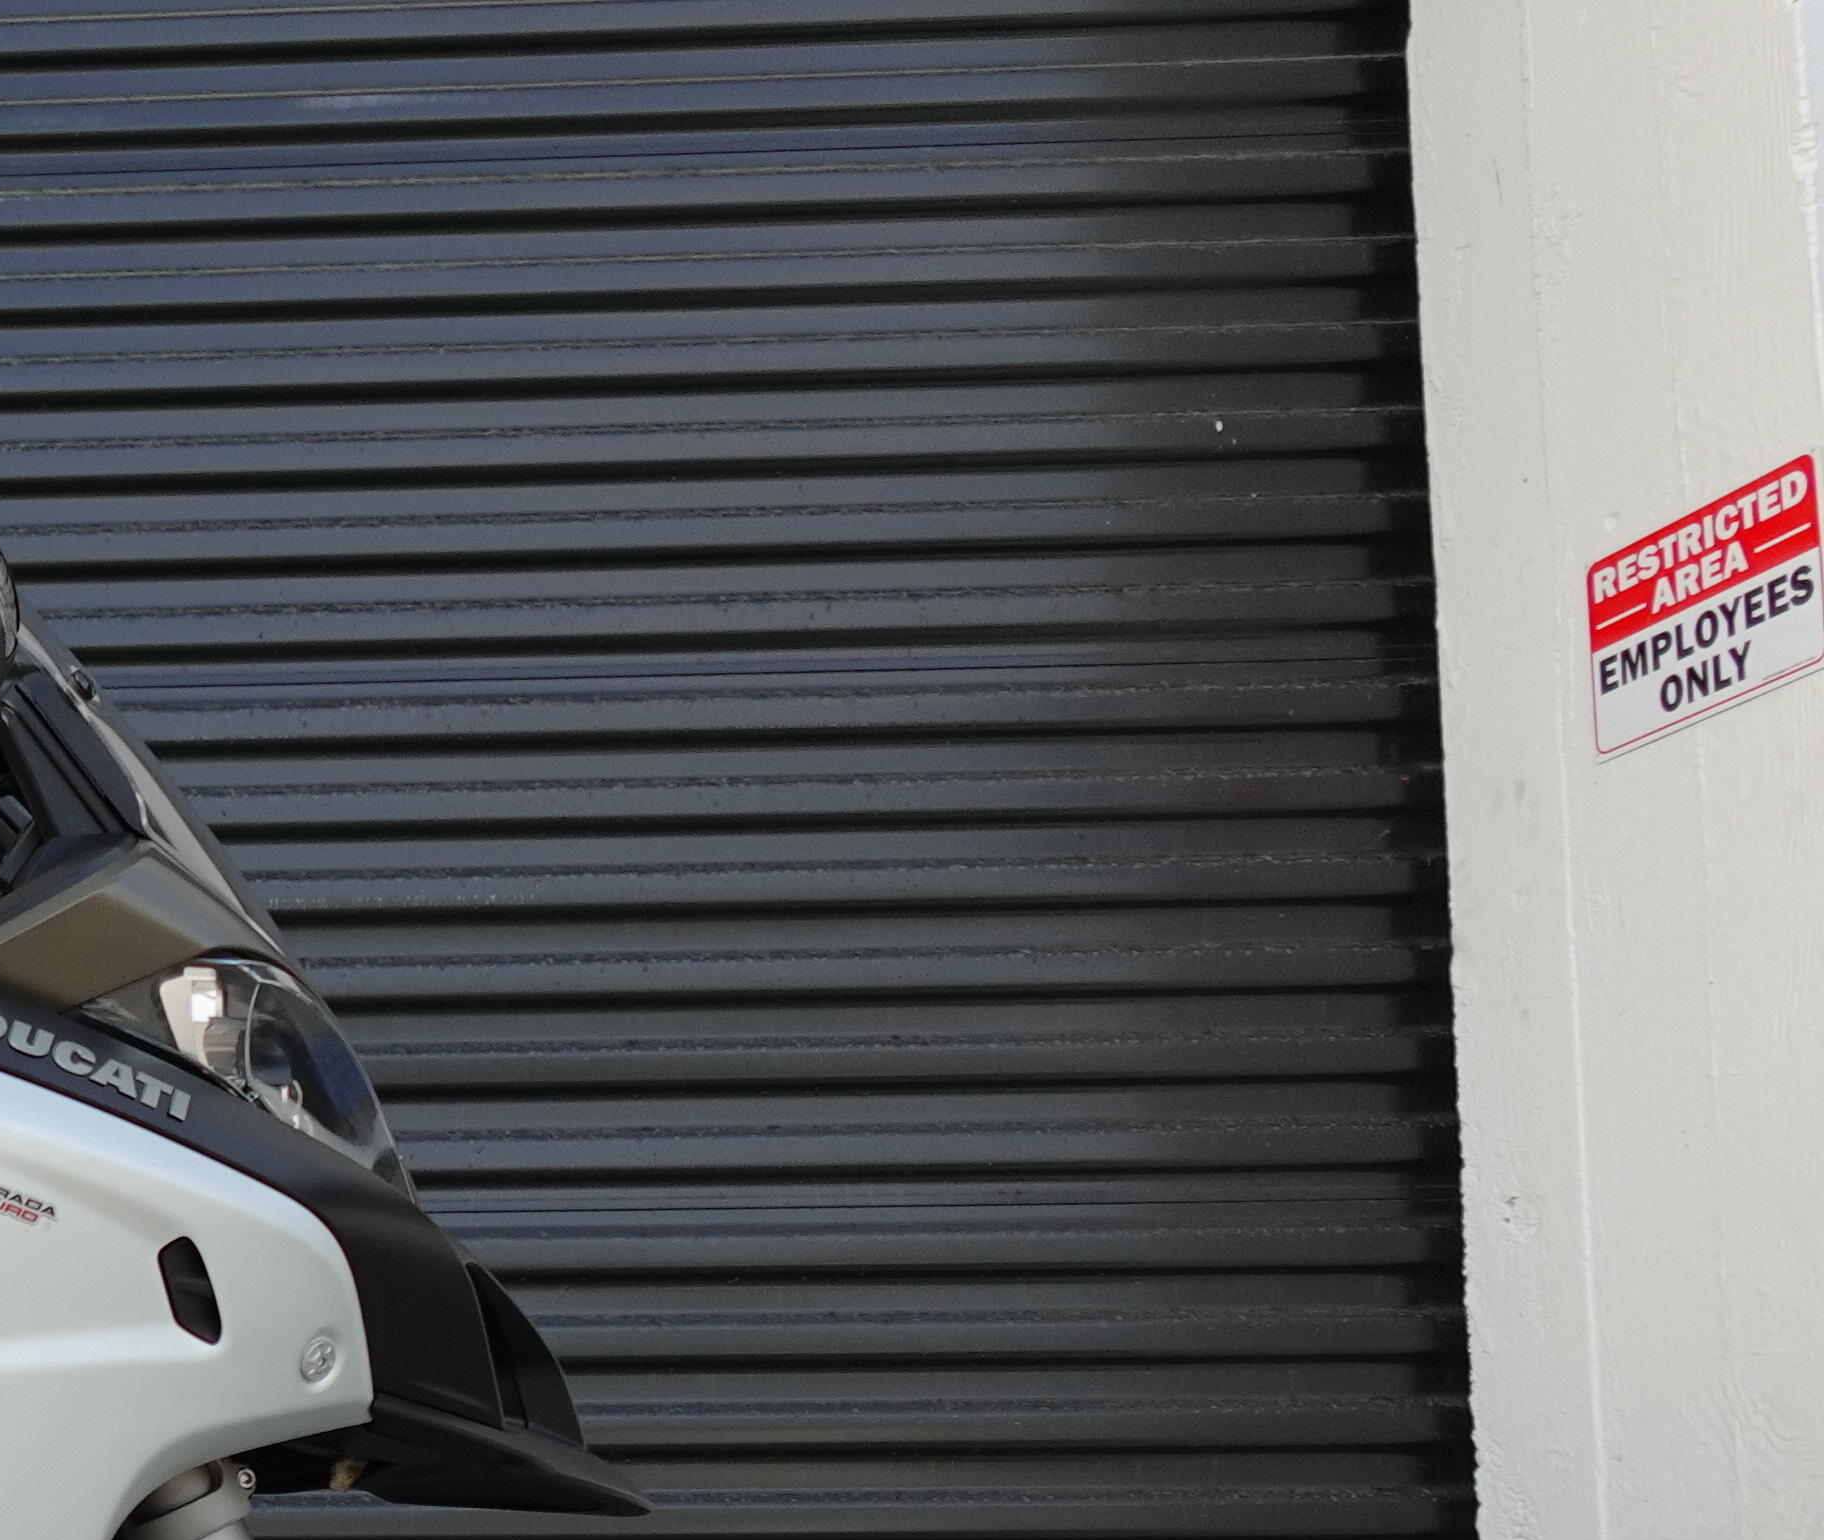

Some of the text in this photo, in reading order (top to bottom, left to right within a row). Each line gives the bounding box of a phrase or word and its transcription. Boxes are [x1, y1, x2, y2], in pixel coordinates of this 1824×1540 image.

[1593, 470, 1808, 604] RESTRICTED
[1651, 541, 1749, 615] AREA
[1600, 565, 1815, 695] EMPLOYEES
[1660, 640, 1752, 712] ONLY
